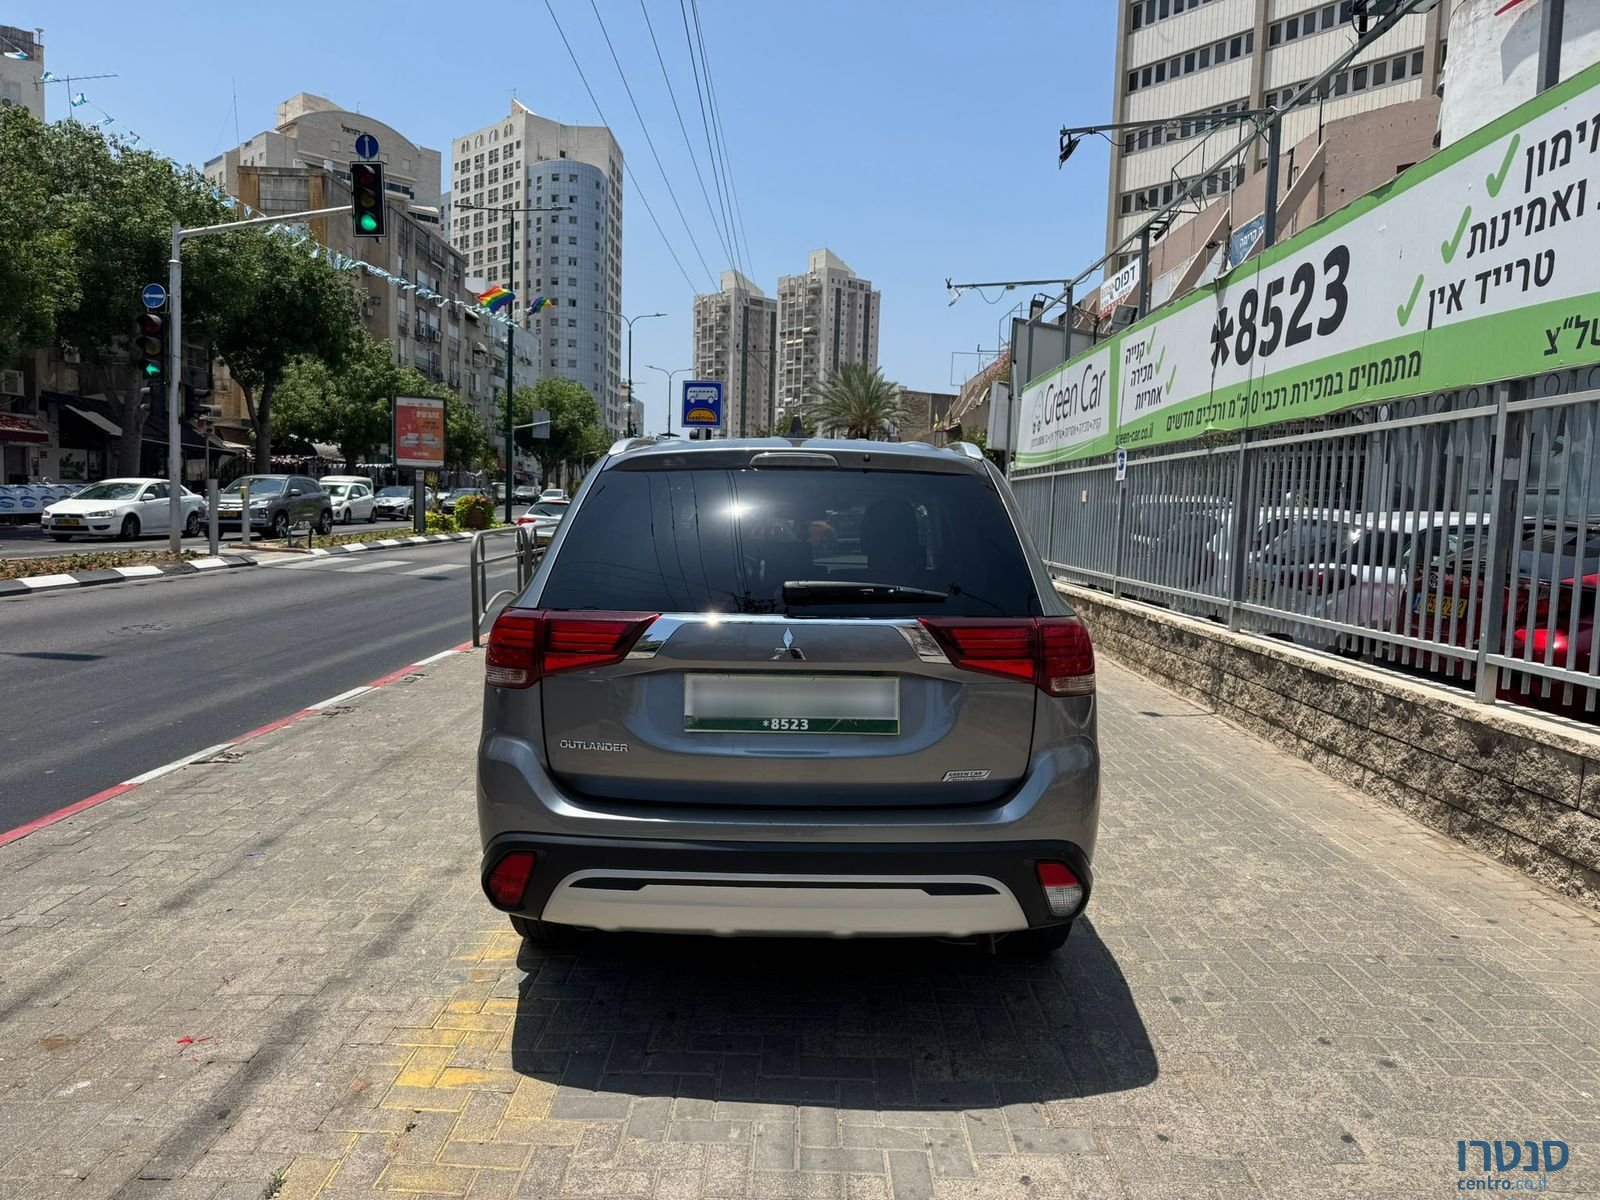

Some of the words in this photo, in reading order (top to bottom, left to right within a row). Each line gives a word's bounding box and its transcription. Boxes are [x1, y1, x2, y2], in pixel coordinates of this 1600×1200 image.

[1466, 178, 1588, 259] ואמינות
[1114, 265, 1136, 292] דפוס
[1475, 248, 1556, 305] טרייד
[1427, 279, 1466, 330] אין
[1125, 341, 1145, 365] קנייה
[1131, 363, 1153, 387] מכירה
[1348, 350, 1421, 392] מתמחים
[1044, 383, 1078, 425] Green
[1080, 363, 1106, 412] Car
[1135, 385, 1163, 411] אחריות
[1261, 386, 1287, 412] רכבי
[1289, 371, 1343, 405] במכירת
[1166, 410, 1194, 432] חדשים
[1196, 401, 1226, 425] ורכבים
[559, 739, 629, 752] OUTLANDER
